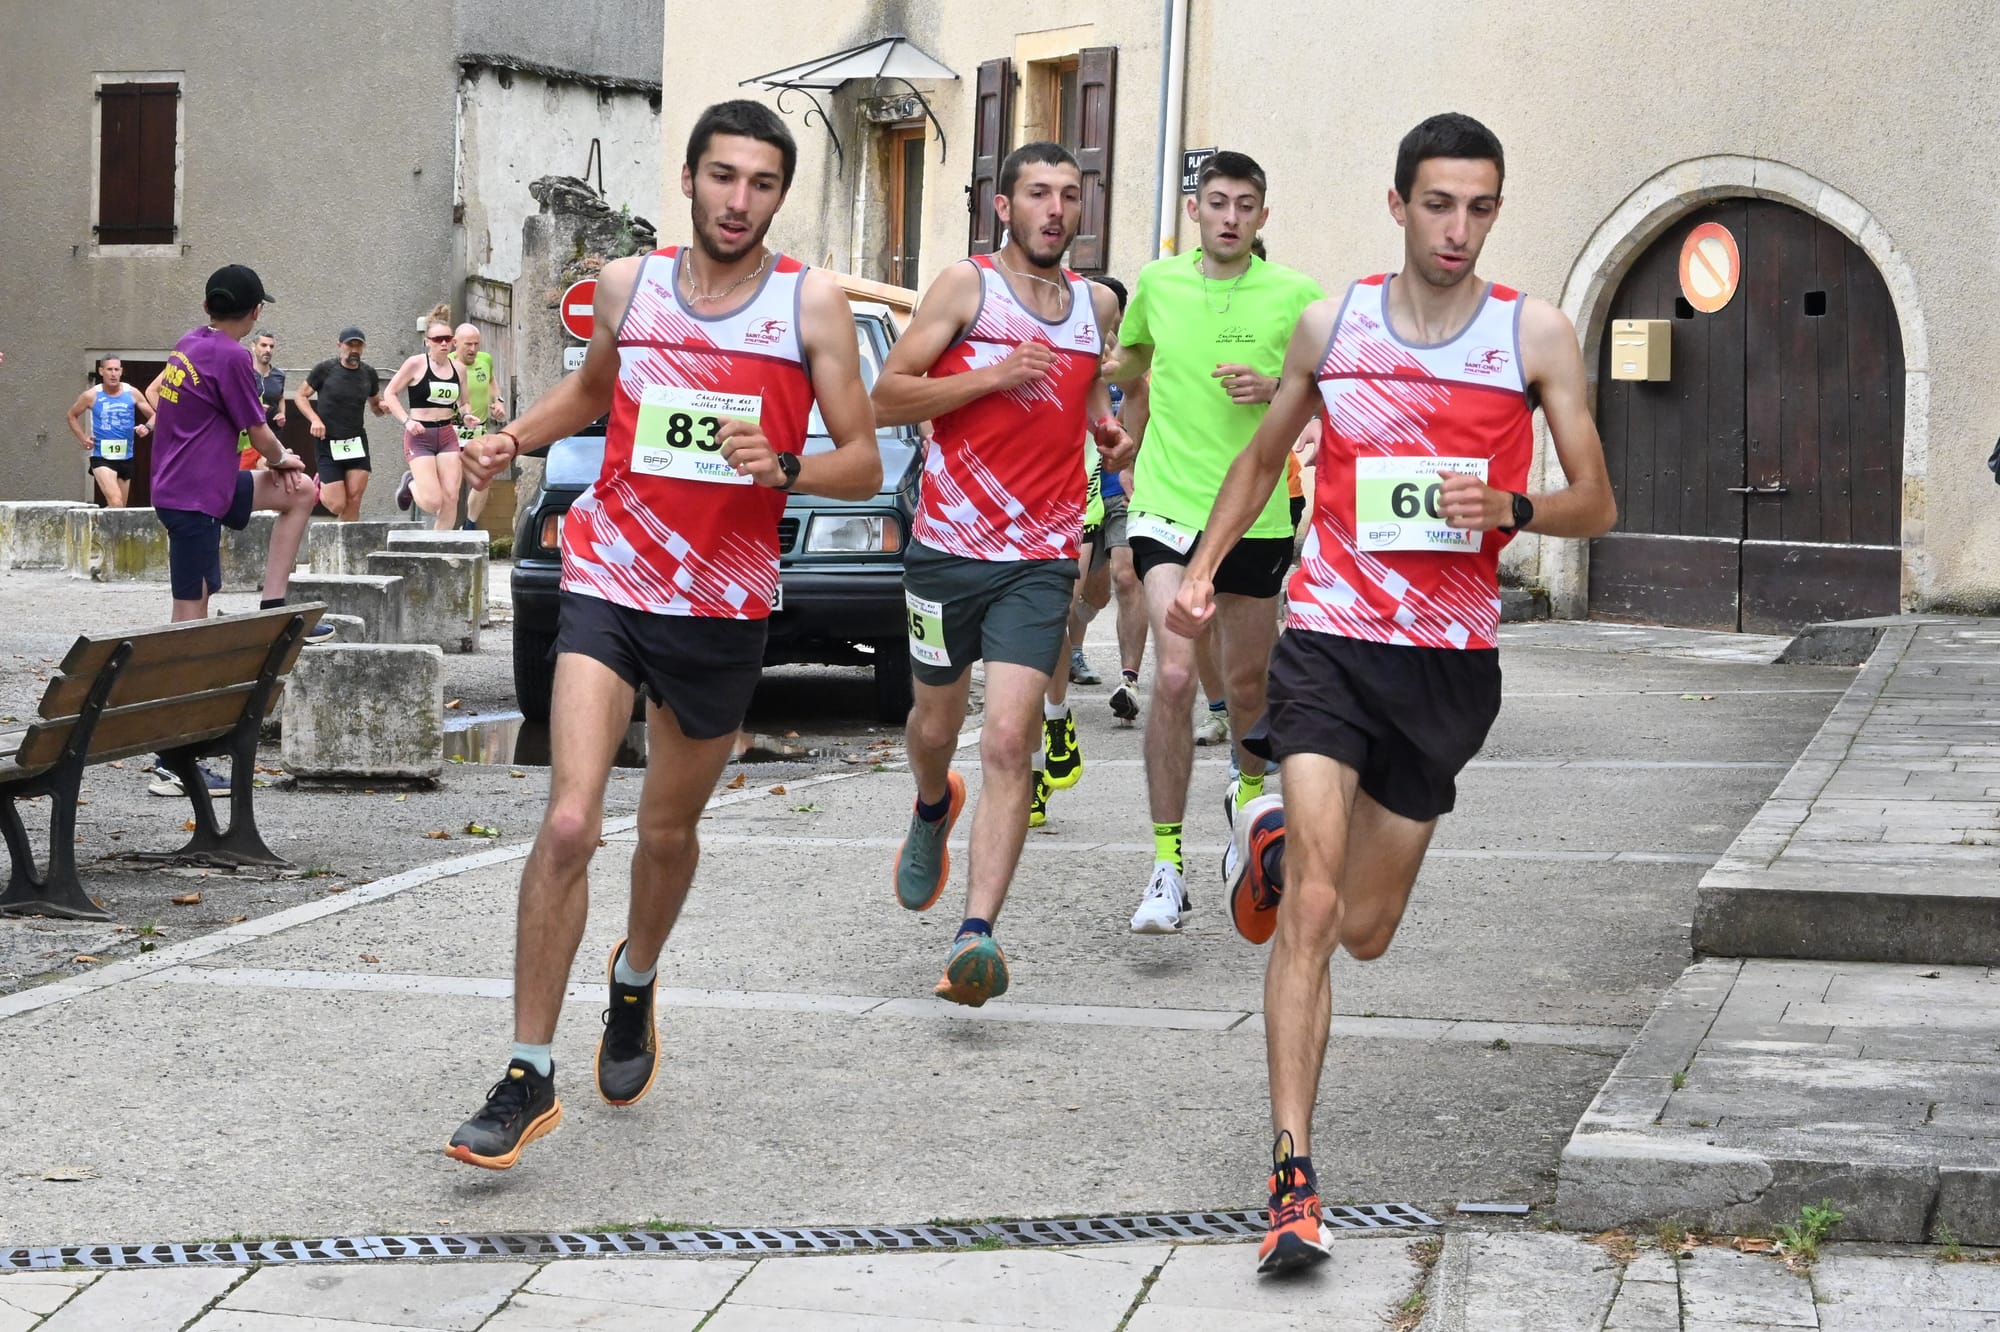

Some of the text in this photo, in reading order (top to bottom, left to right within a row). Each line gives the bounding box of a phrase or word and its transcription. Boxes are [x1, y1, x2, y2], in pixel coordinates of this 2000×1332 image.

[437, 388, 452, 398] 20
[696, 393, 734, 404] Challenge
[460, 431, 474, 440] 42
[666, 412, 723, 452] 83
[108, 445, 121, 453] 19
[343, 444, 351, 453] 6
[643, 455, 668, 464] BFP
[694, 461, 731, 472] TUFF'S
[1369, 531, 1396, 539] BFP
[1425, 530, 1462, 539] TUFF'S
